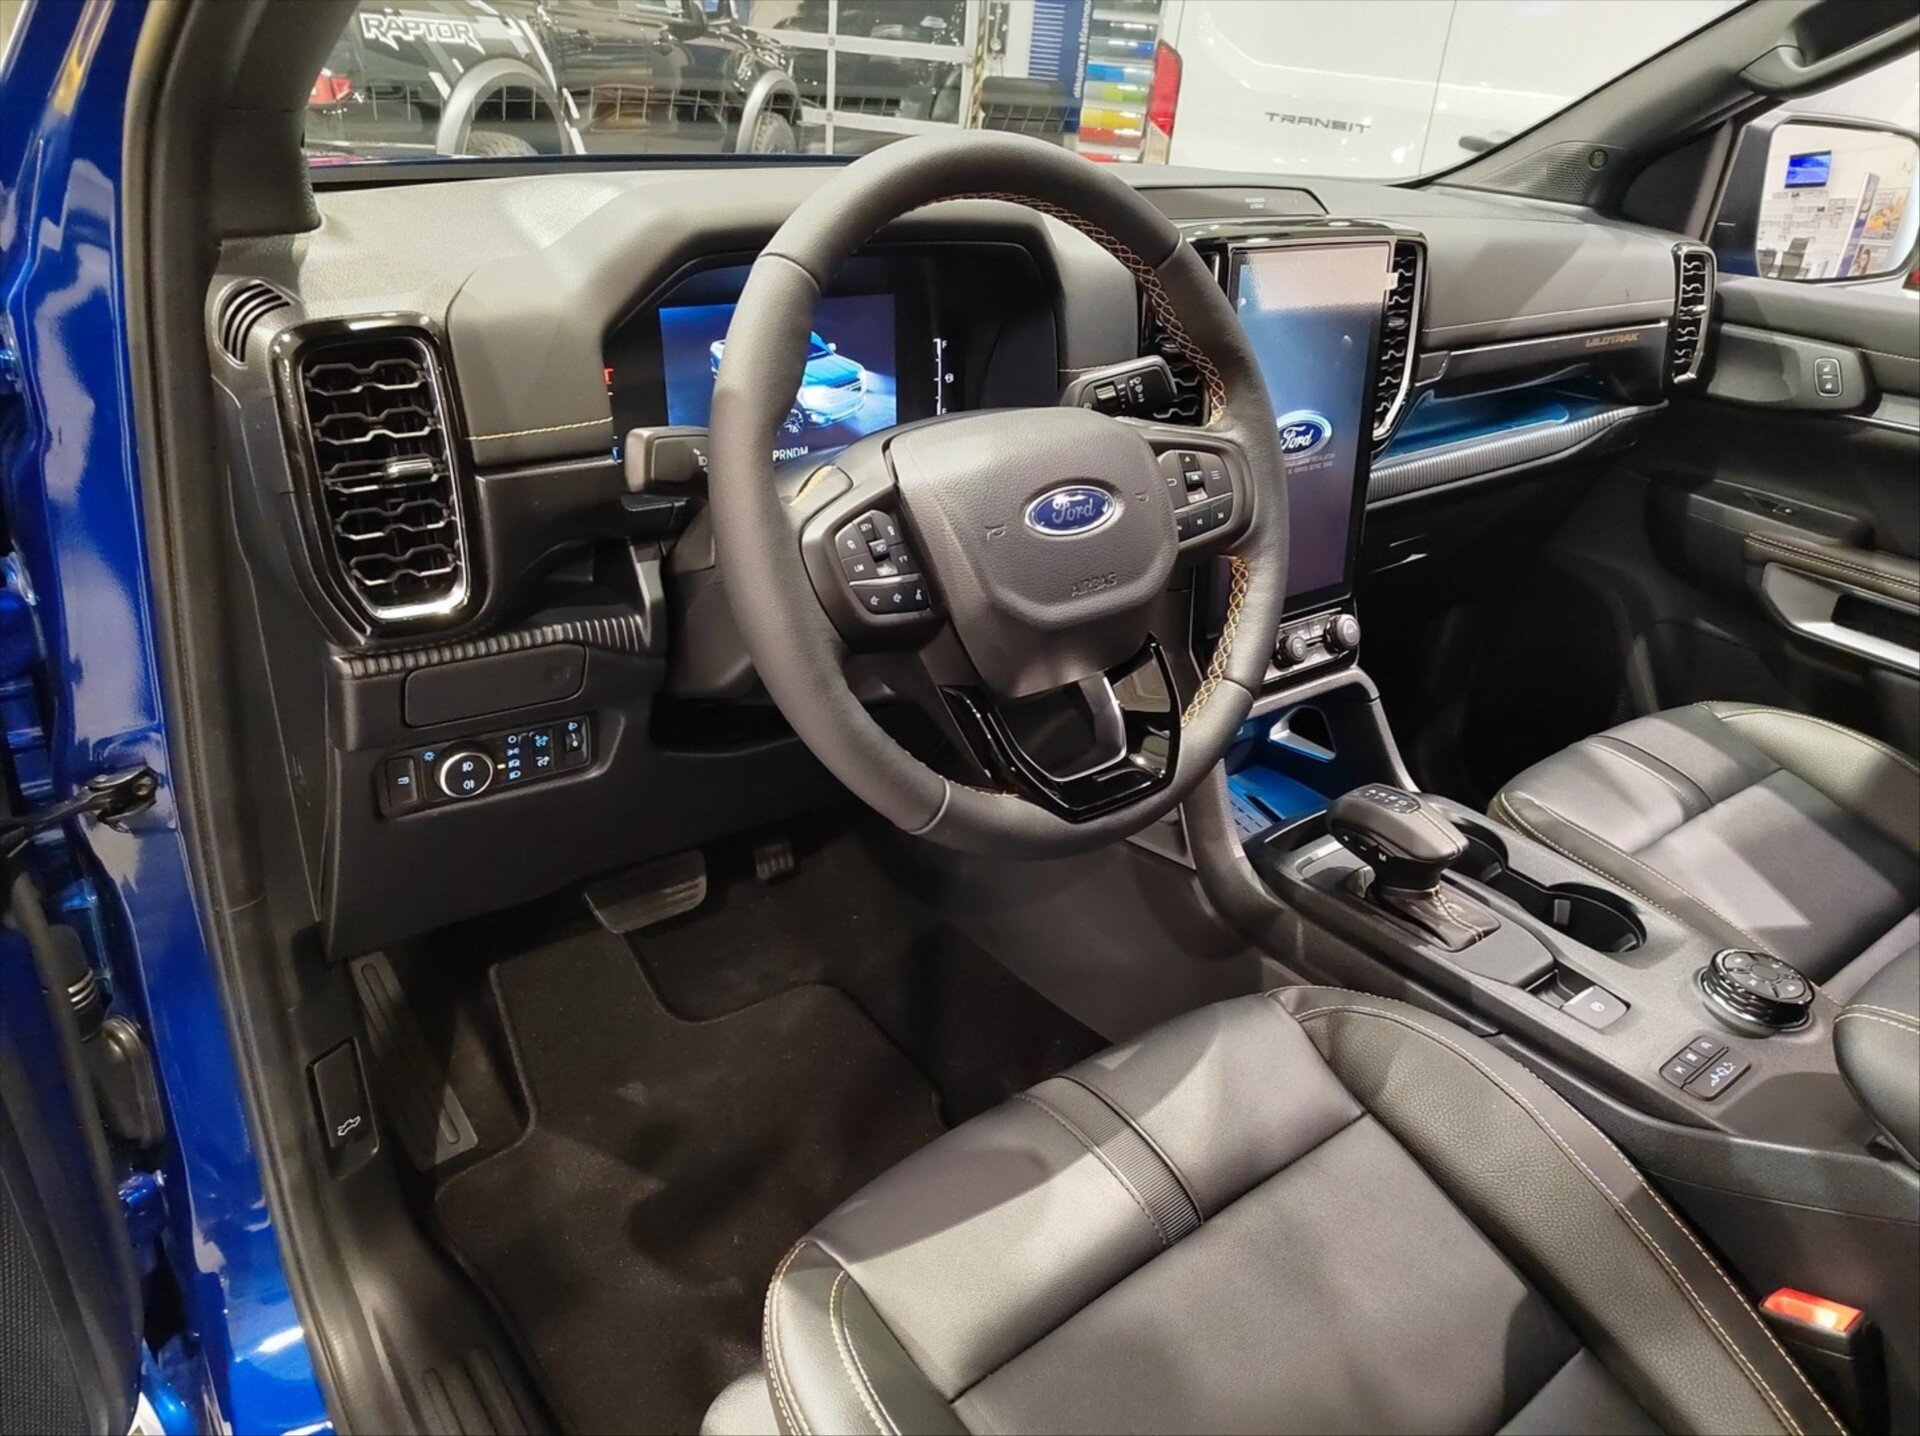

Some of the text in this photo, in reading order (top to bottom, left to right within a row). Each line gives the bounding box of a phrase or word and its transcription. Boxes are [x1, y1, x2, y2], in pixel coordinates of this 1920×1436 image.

[360, 12, 485, 55] RAPTOR
[1265, 112, 1371, 133] TRANSIT
[1280, 425, 1315, 451] Ford
[1051, 492, 1097, 525] Ford
